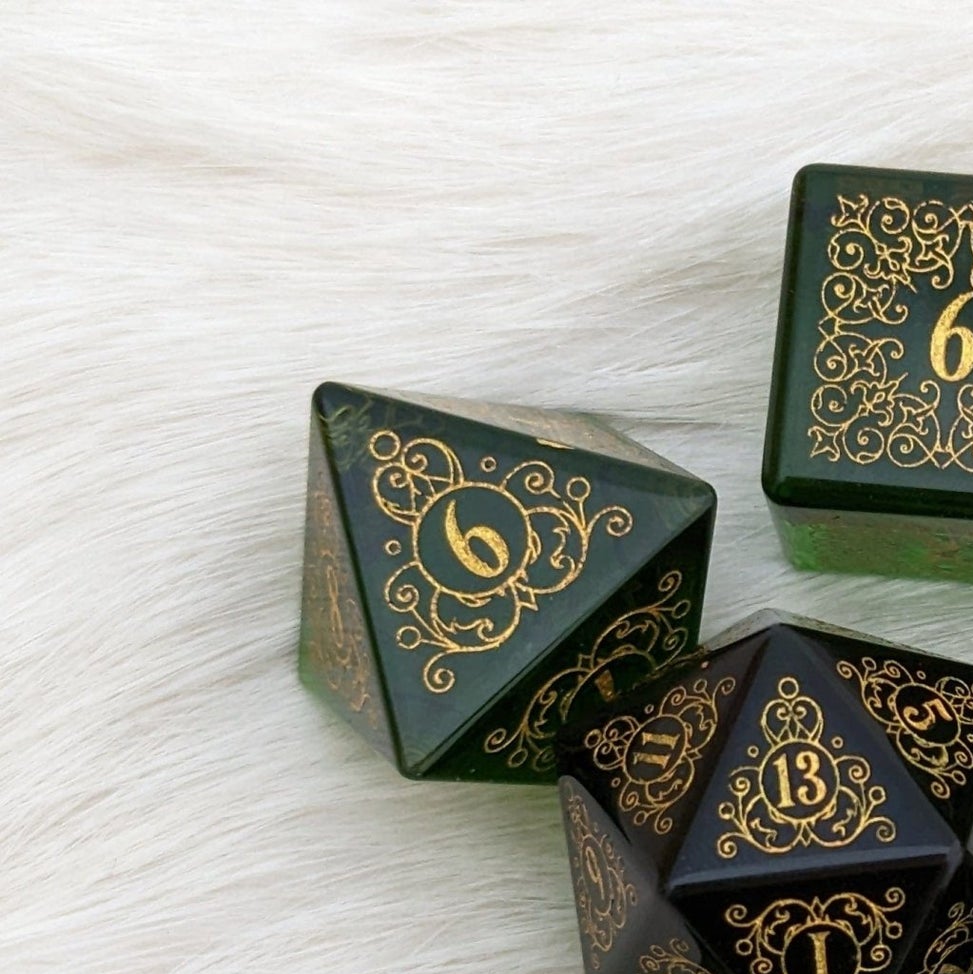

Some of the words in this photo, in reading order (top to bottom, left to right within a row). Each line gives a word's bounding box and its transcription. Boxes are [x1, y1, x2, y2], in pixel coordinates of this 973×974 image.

[445, 500, 509, 577] 6
[903, 698, 952, 731] 5
[633, 732, 680, 769] 11
[775, 750, 825, 809] 13
